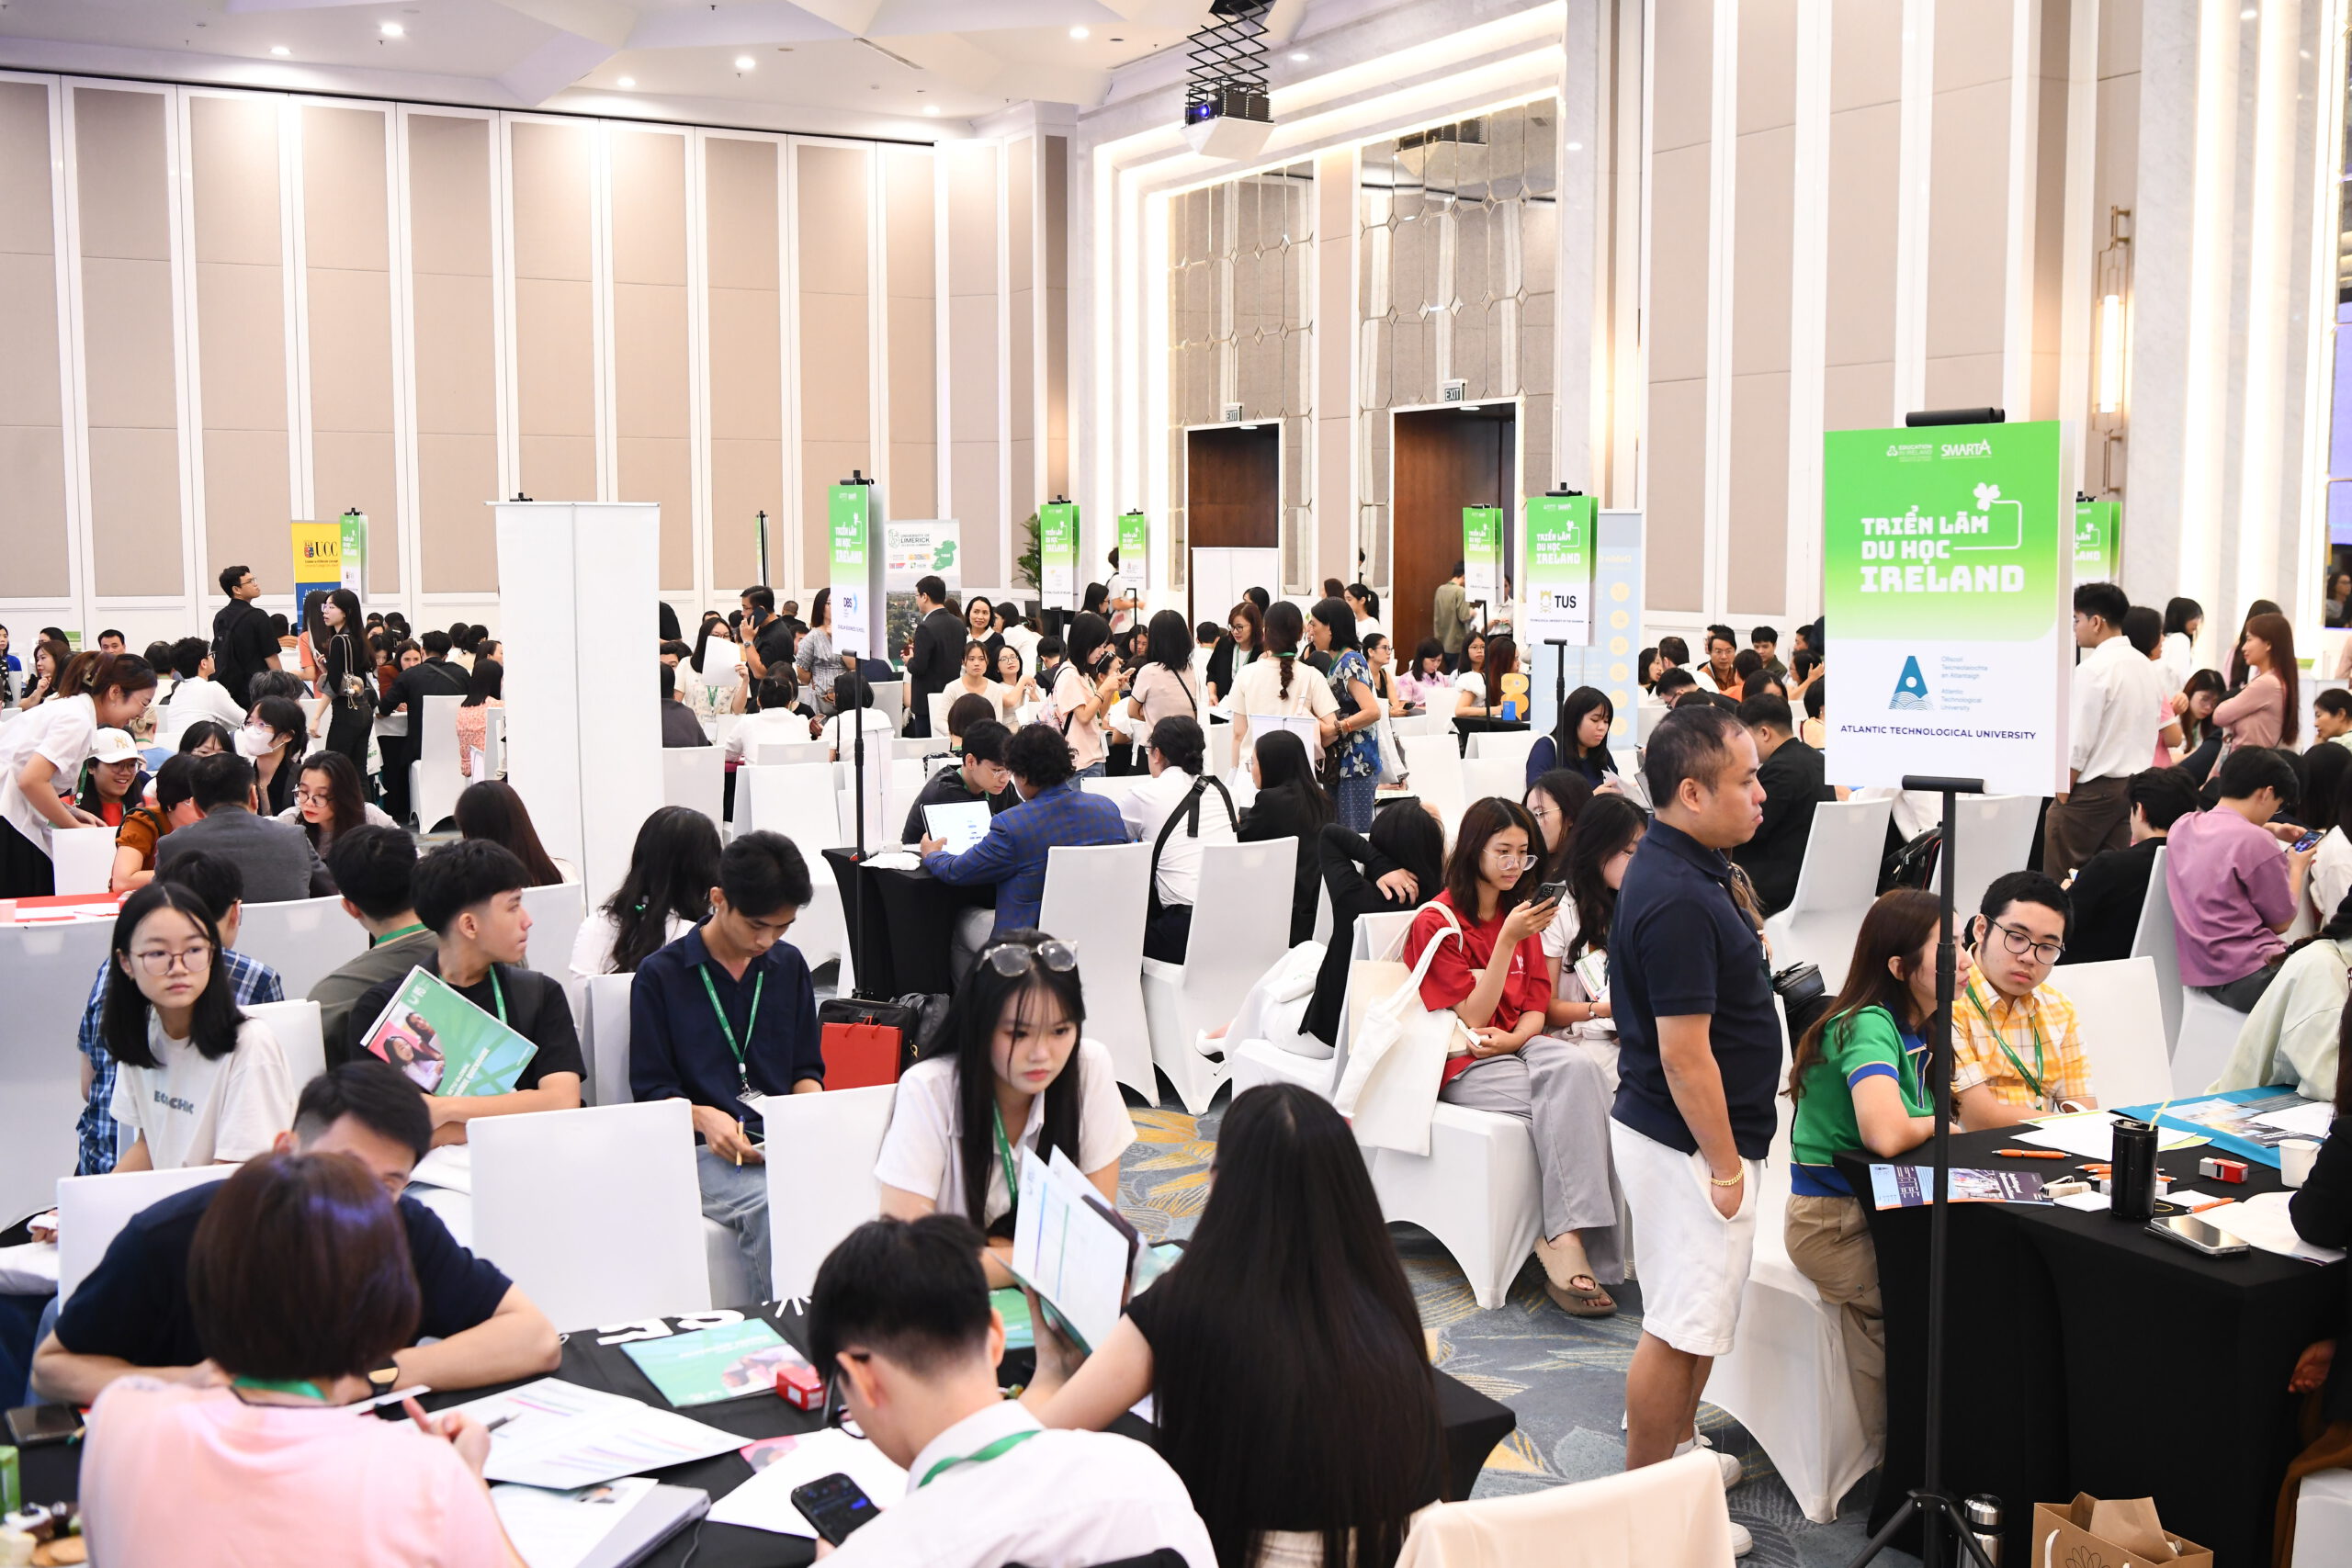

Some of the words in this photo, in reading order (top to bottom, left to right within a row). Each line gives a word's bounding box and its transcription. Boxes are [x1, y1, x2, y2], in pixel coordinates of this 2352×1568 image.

[1445, 388, 1460, 400] EXIT
[1861, 504, 1933, 536] TRIỂN
[1939, 511, 1989, 535] LÃM
[315, 541, 338, 557] UCC
[1861, 540, 1898, 559] DU
[1901, 539, 1951, 565] HỌC
[1537, 554, 1580, 565] IRELAND
[1861, 565, 2025, 592] IRELAND
[1555, 595, 1577, 608] TUS
[1840, 725, 1887, 734] ATLANTIC
[1890, 727, 1973, 737] TECHNOLOGICAL
[1975, 730, 2036, 739] UNIVERSITY
